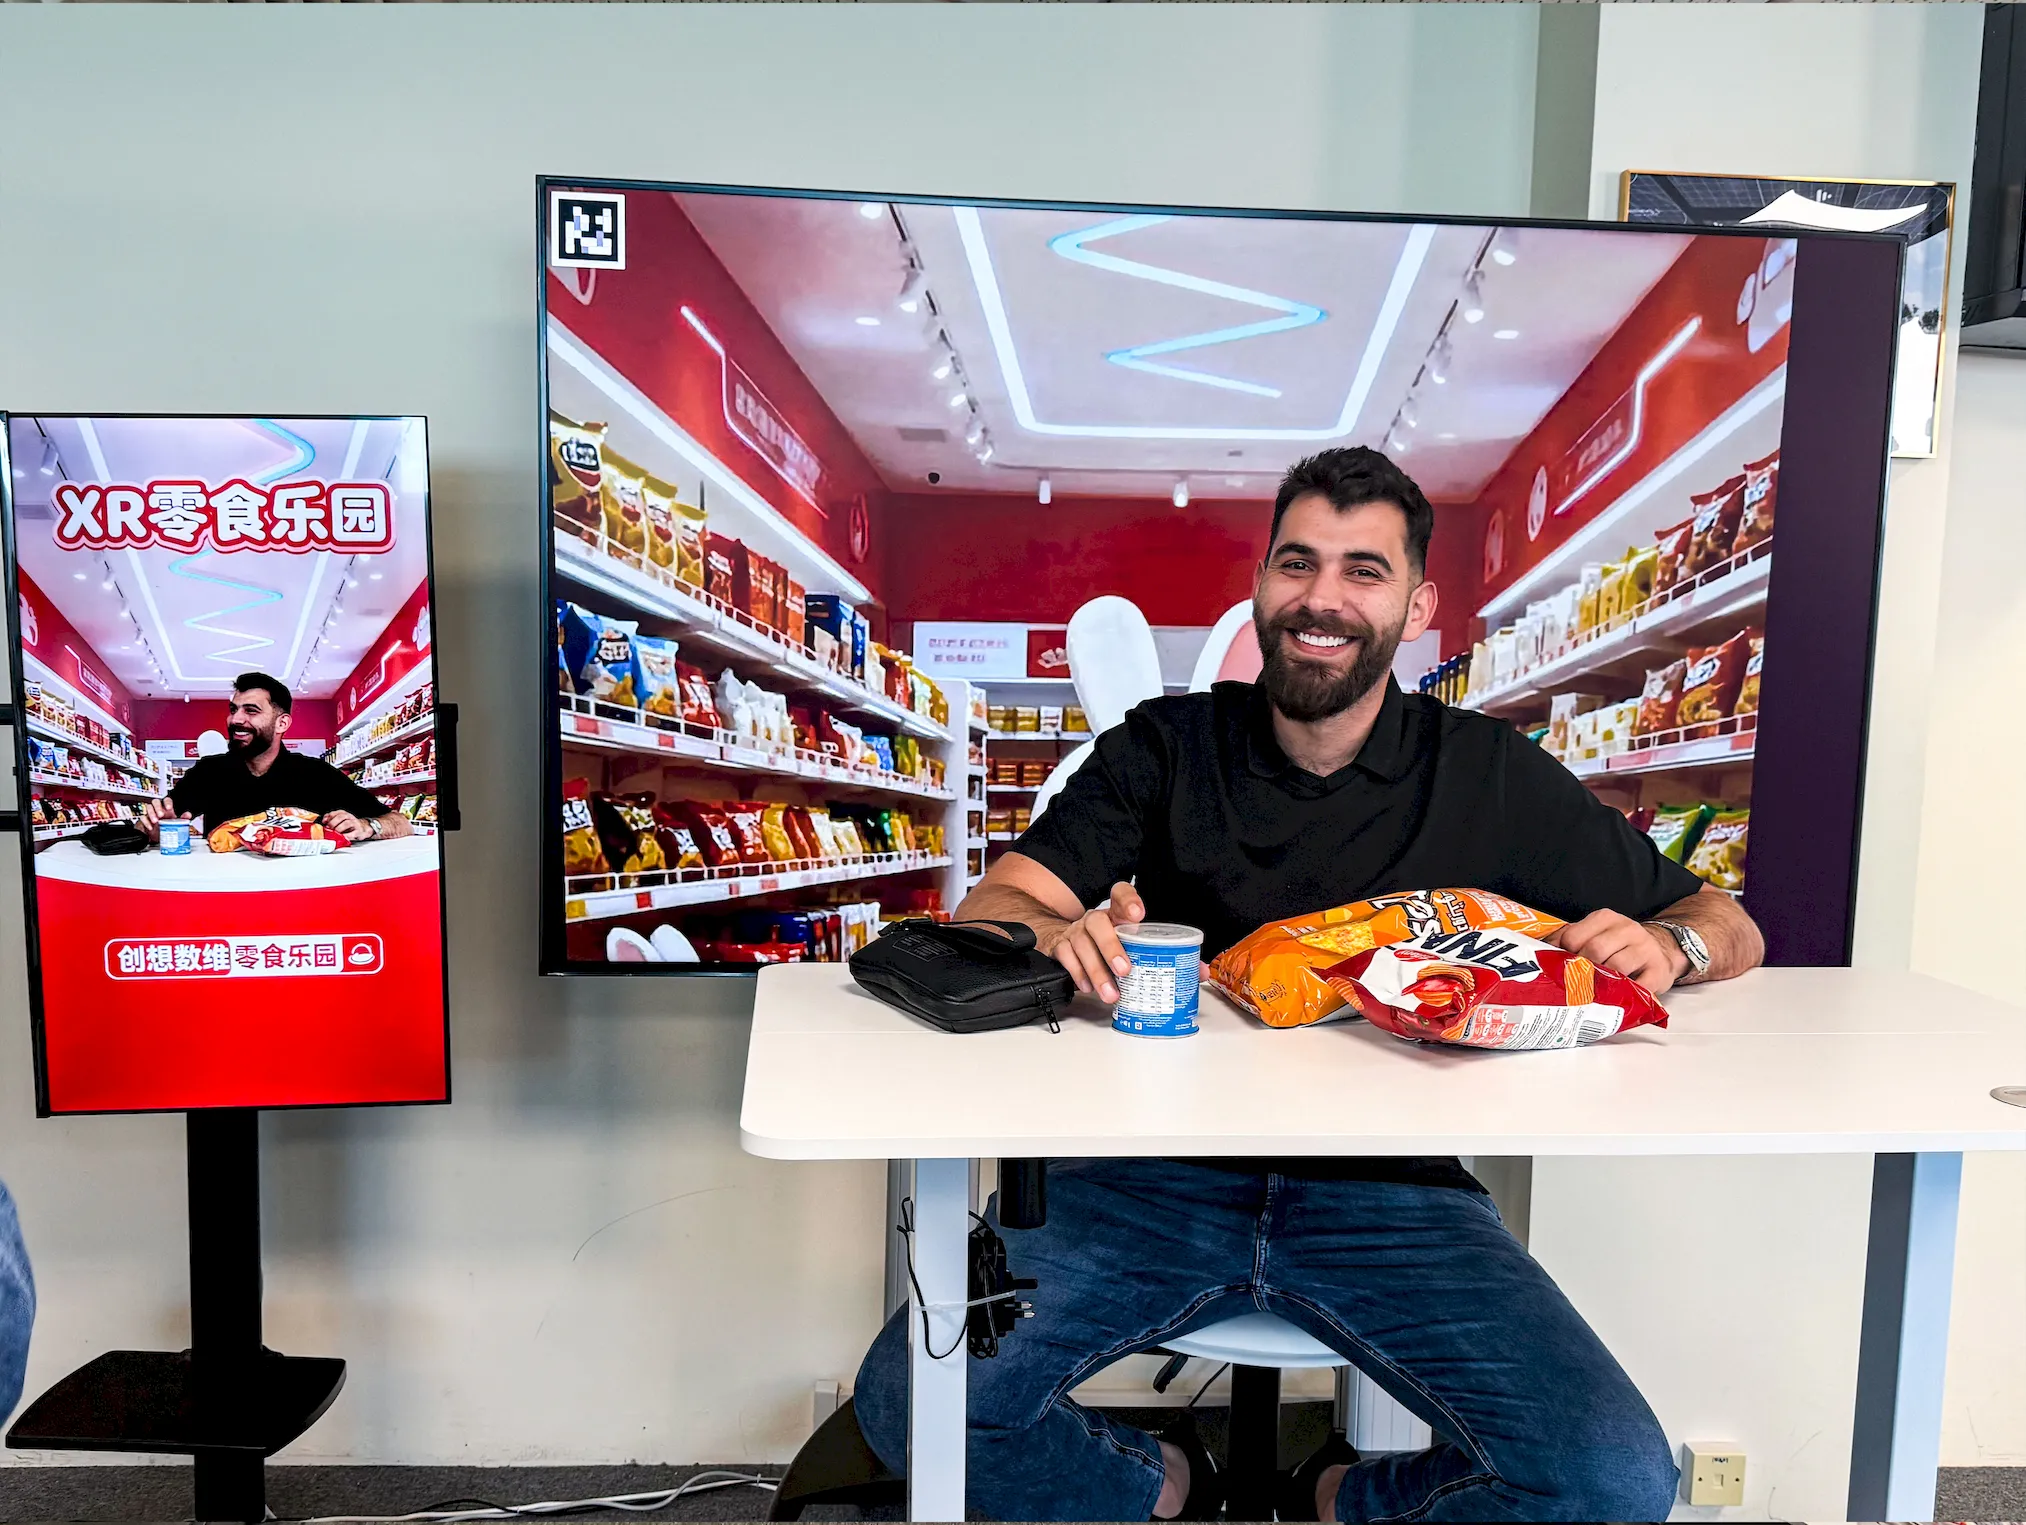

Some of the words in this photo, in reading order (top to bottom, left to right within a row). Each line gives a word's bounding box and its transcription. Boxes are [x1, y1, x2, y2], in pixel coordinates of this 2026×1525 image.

[60, 484, 387, 543] XR零食乐园
[118, 944, 230, 973] 创想数维
[235, 943, 336, 969] 零食乐园
